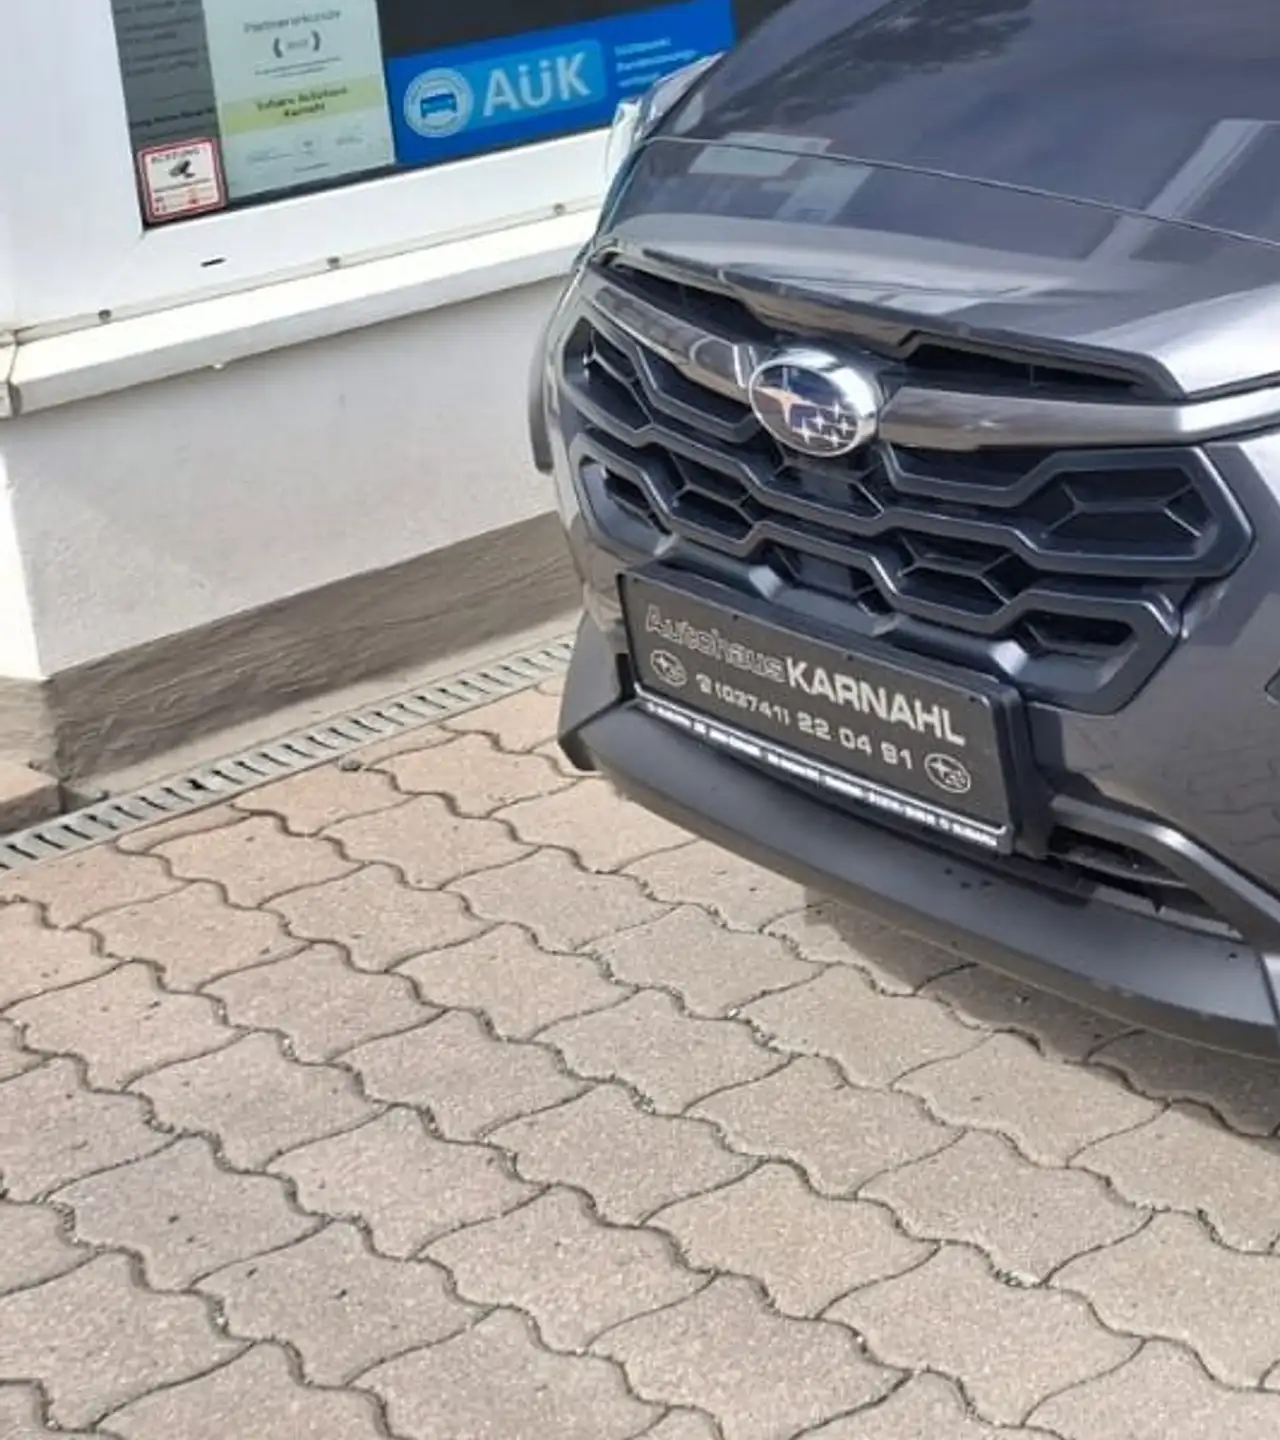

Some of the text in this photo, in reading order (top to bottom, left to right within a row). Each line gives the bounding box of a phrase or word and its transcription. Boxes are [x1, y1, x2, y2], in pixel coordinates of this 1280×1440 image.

[482, 51, 592, 117] AÜK
[796, 711, 832, 742] 22
[838, 727, 873, 758] 04
